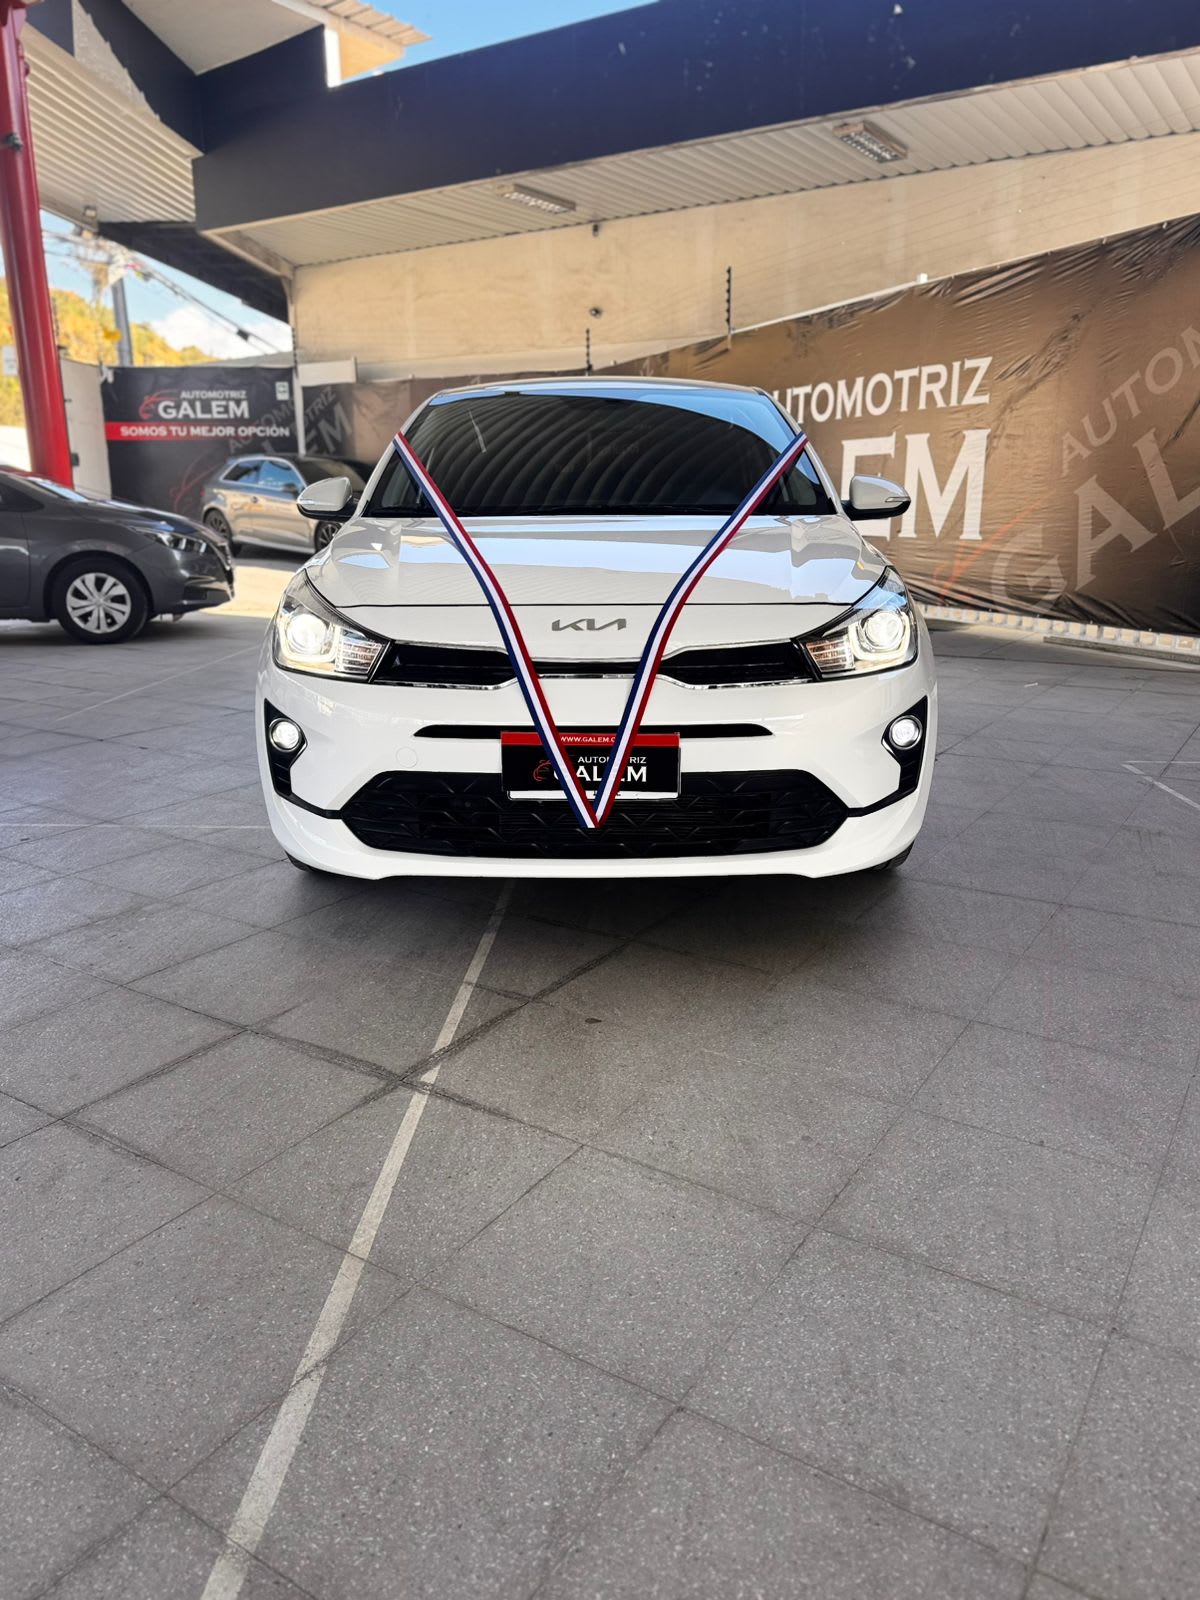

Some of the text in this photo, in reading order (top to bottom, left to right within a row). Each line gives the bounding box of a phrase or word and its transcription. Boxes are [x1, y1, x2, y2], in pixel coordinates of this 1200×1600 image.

[180, 390, 247, 399] AUTOMOTRIZ
[774, 356, 993, 424] UTOMOTRIZ
[158, 401, 250, 419] GALEM
[120, 424, 290, 437] SOMOS TU MEJOR OPCIÓN
[991, 427, 1200, 608] GAL
